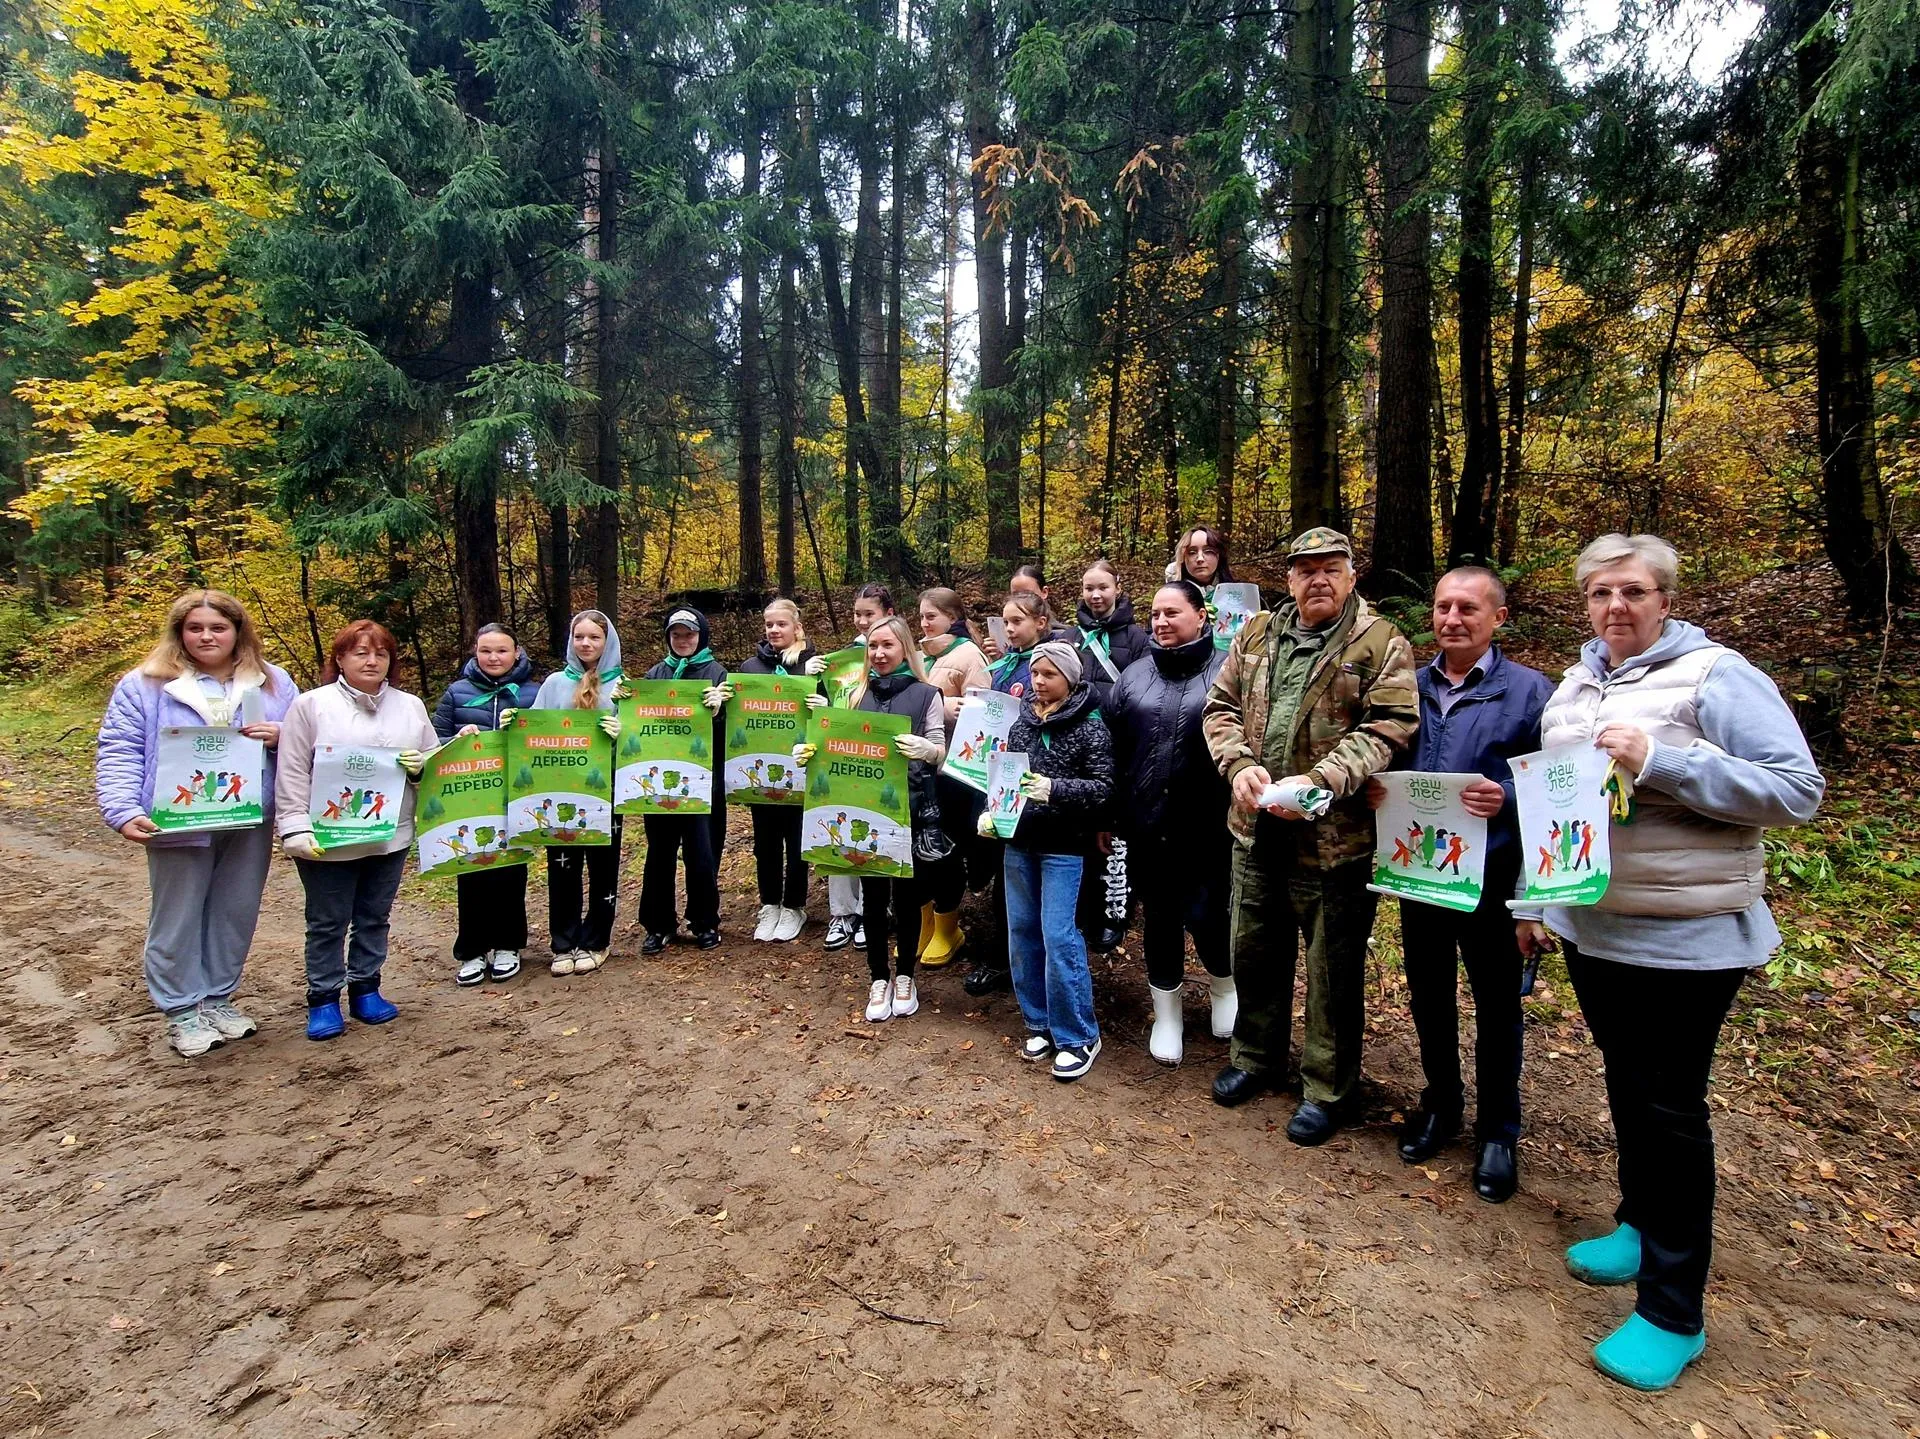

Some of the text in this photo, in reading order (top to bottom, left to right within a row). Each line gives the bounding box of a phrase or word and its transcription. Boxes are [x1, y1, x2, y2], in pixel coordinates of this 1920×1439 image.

[639, 707, 692, 717] НАШ ЛЕС
[744, 700, 796, 712] НАШ ЛЕС
[639, 724, 692, 737] ДЕРЕВО
[745, 718, 796, 731] ДЕРЕВО
[528, 737, 589, 747] НАШ ЛЕС
[828, 740, 886, 758] НАШ ЛЕС
[439, 758, 501, 775] НАШ ЛЕС
[531, 756, 588, 768] ДЕРЕВО
[828, 761, 885, 780] ДЕРЕВО
[441, 776, 504, 797] ДЕРЕВО
